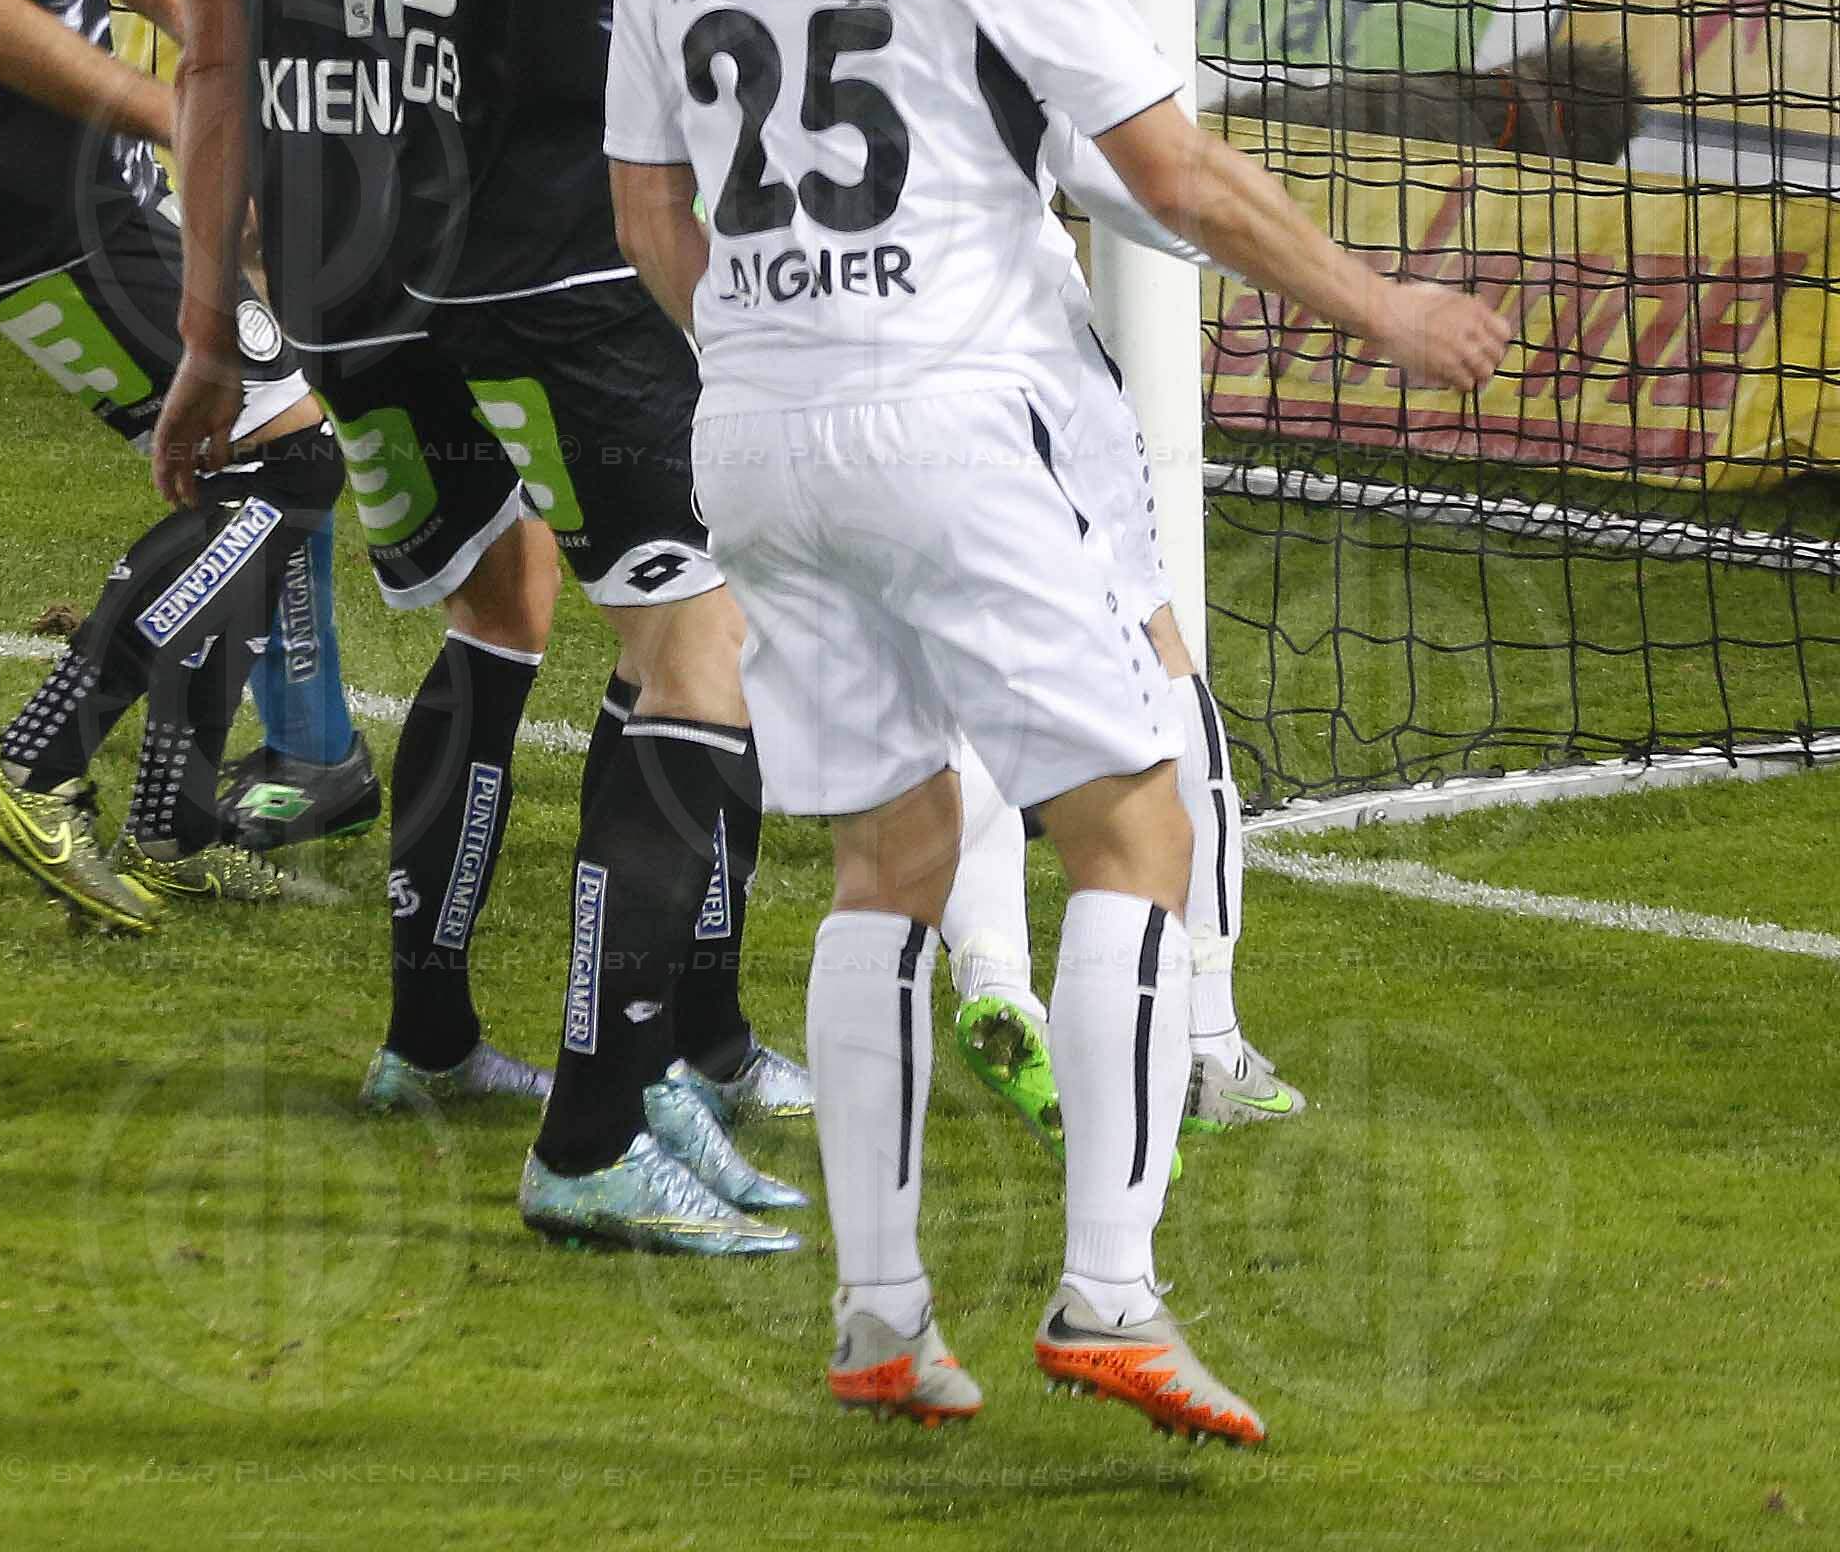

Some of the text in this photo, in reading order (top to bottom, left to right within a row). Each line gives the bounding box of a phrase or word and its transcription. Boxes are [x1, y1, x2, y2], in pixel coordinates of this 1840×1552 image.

[260, 56, 404, 136] KIEN
[682, 6, 910, 239] 25
[147, 504, 274, 635] PUNTIGAMER
[443, 774, 499, 939] PUNTIGAMER
